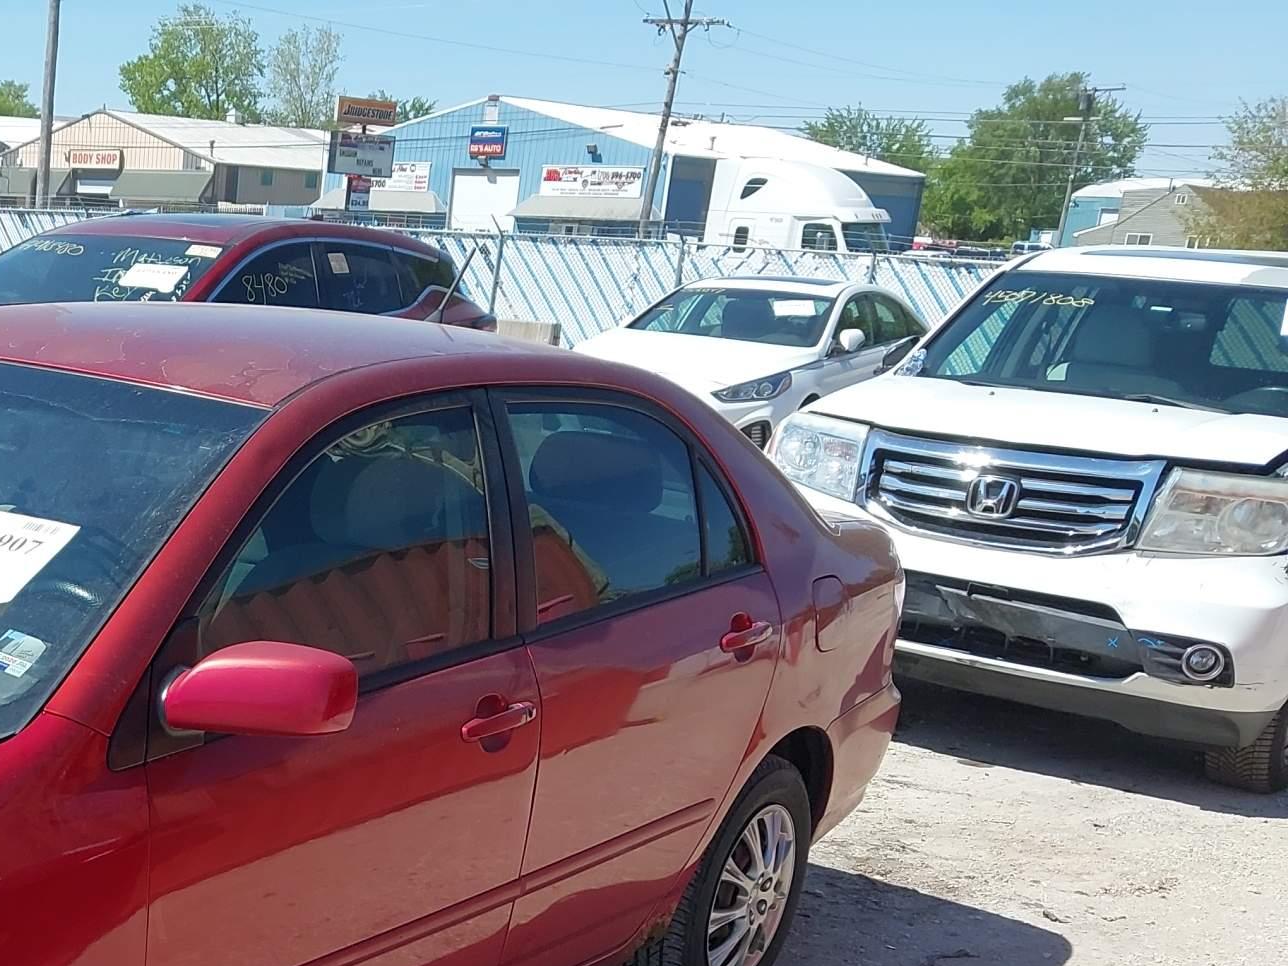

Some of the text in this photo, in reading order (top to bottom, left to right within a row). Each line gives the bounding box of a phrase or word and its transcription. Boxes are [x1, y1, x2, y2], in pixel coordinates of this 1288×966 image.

[484, 144, 502, 153] AUTO
[72, 152, 117, 164] BODY SHOP
[242, 272, 288, 305] 8480
